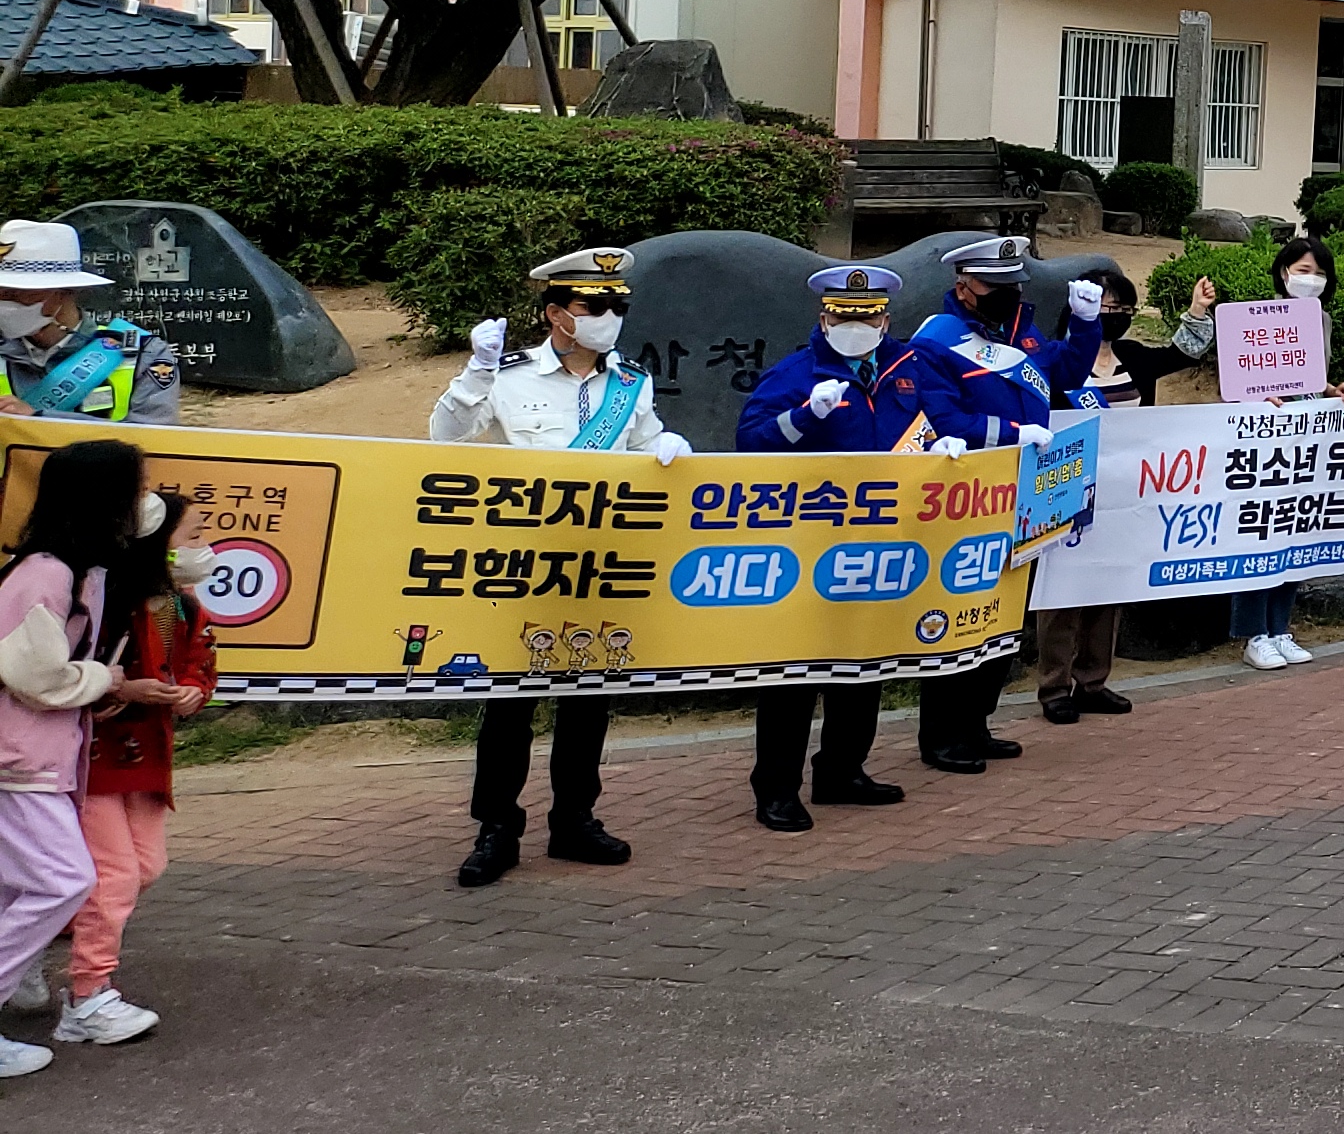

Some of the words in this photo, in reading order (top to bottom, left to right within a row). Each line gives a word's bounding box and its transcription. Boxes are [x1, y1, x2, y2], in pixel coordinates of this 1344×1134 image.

[145, 250, 182, 279] 학교
[1243, 328, 1269, 346] 작은
[1273, 326, 1299, 345] 관심
[1238, 351, 1277, 371] 하나의
[1281, 349, 1306, 367] 희망
[1139, 445, 1207, 498] NO!
[1224, 443, 1319, 490] 청소년
[416, 473, 669, 529] 운전자는
[690, 479, 899, 529] 안전속도
[200, 511, 282, 532] ZONE
[1158, 502, 1223, 552] YES!
[208, 565, 264, 598] 30
[402, 548, 656, 599] 보행자는
[683, 552, 783, 599] 서다
[829, 549, 916, 594] 보다
[954, 537, 1007, 587] 걷다
[1161, 560, 1229, 582] 여성가족부
[1242, 555, 1278, 574] 산청군
